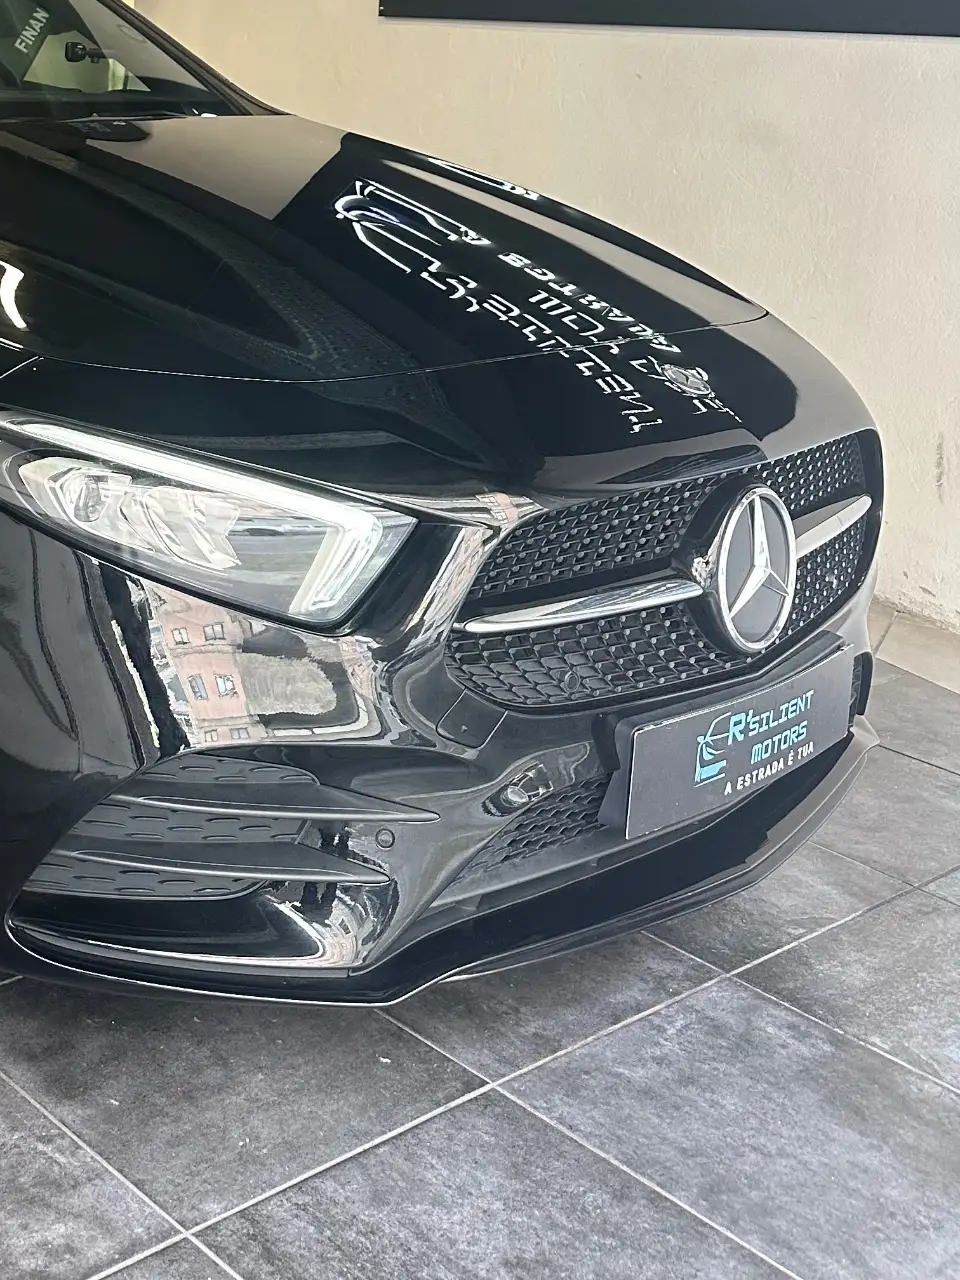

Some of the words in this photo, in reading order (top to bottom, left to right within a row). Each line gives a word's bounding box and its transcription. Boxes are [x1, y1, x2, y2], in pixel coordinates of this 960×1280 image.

[727, 689, 815, 746] R'SILIENT
[750, 720, 808, 764] MOTORS
[724, 781, 732, 796] A
[736, 757, 785, 791] ESTRADA
[797, 741, 814, 760] TUA
